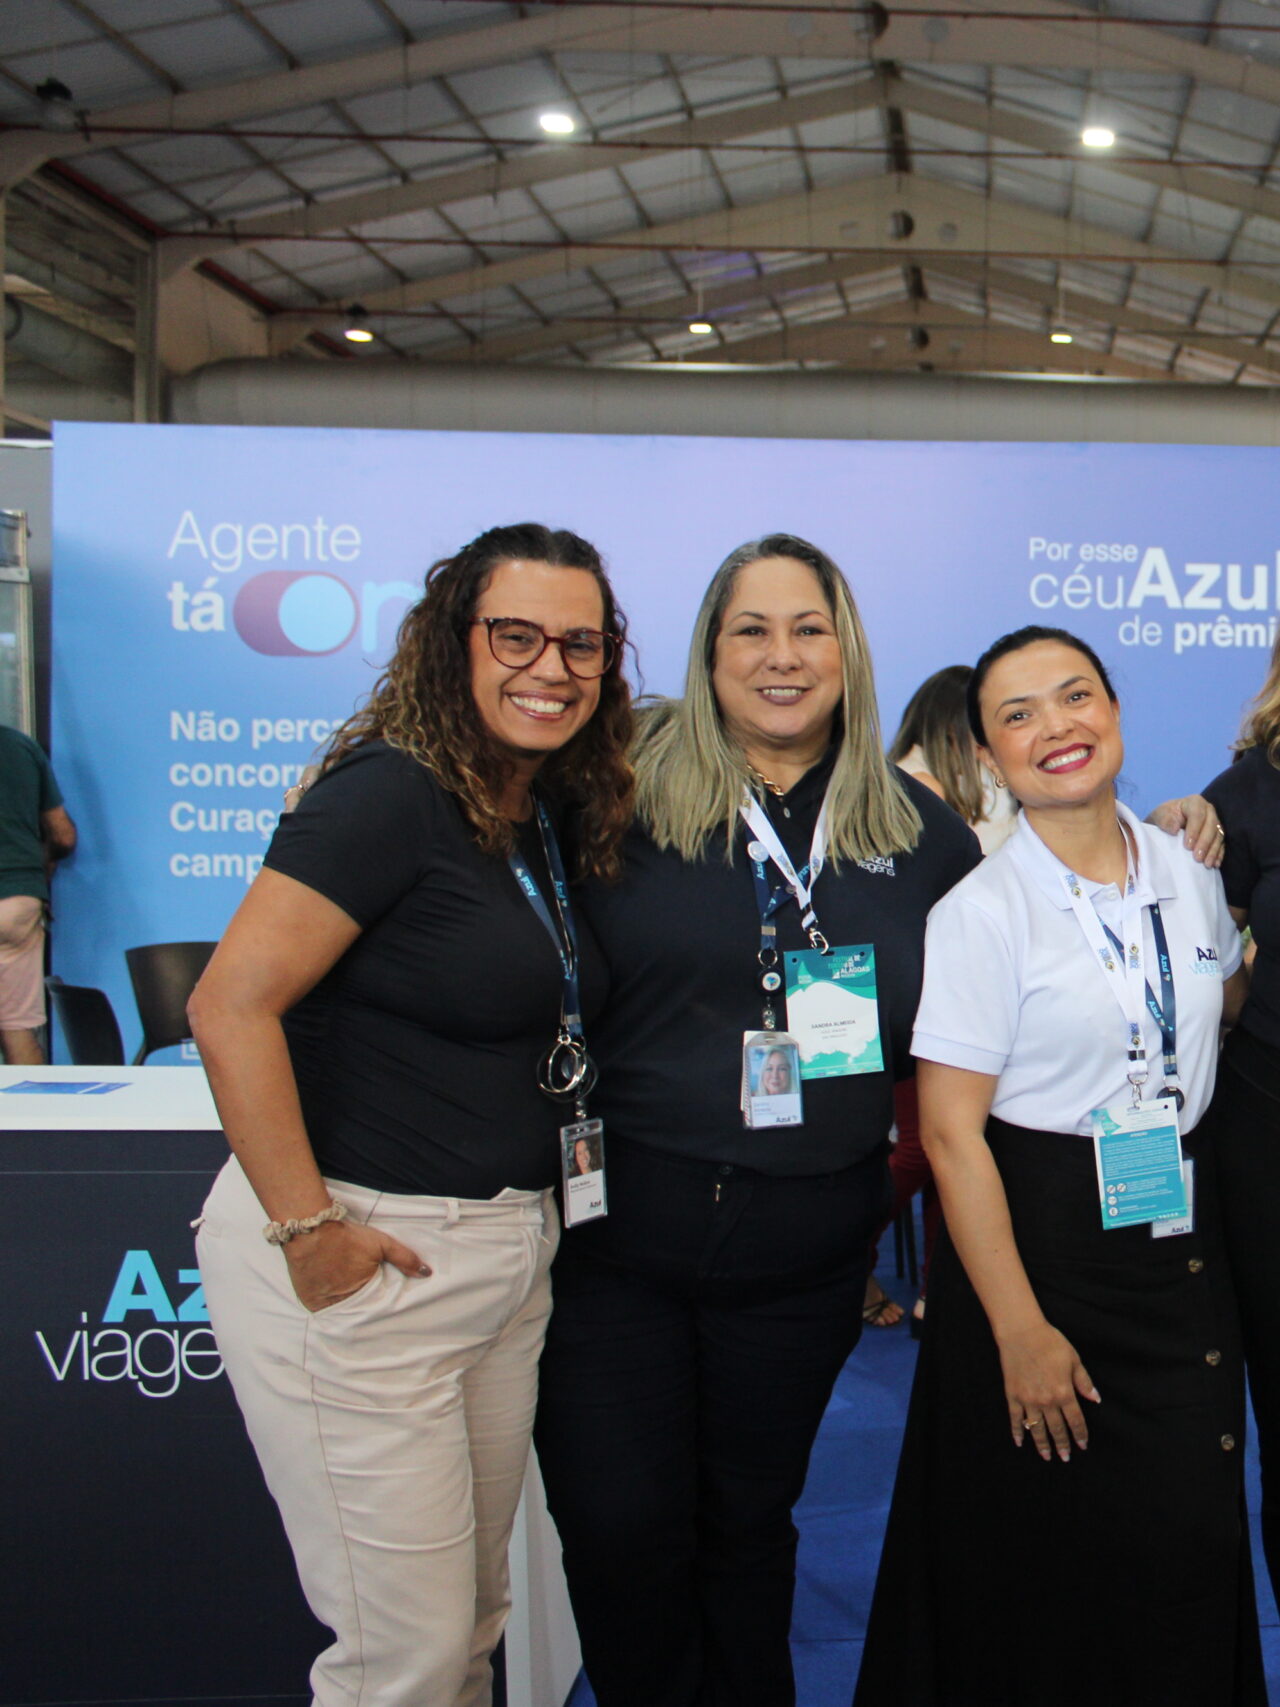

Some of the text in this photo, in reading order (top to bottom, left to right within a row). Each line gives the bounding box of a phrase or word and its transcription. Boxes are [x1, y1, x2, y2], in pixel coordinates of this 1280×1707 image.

[167, 510, 362, 573] Agente
[1029, 537, 1138, 562] Por esse
[167, 577, 226, 633] tá
[1029, 564, 1124, 610] céu
[1118, 614, 1162, 646] de
[169, 710, 346, 750] Não perc
[35, 1311, 225, 1398] viage
